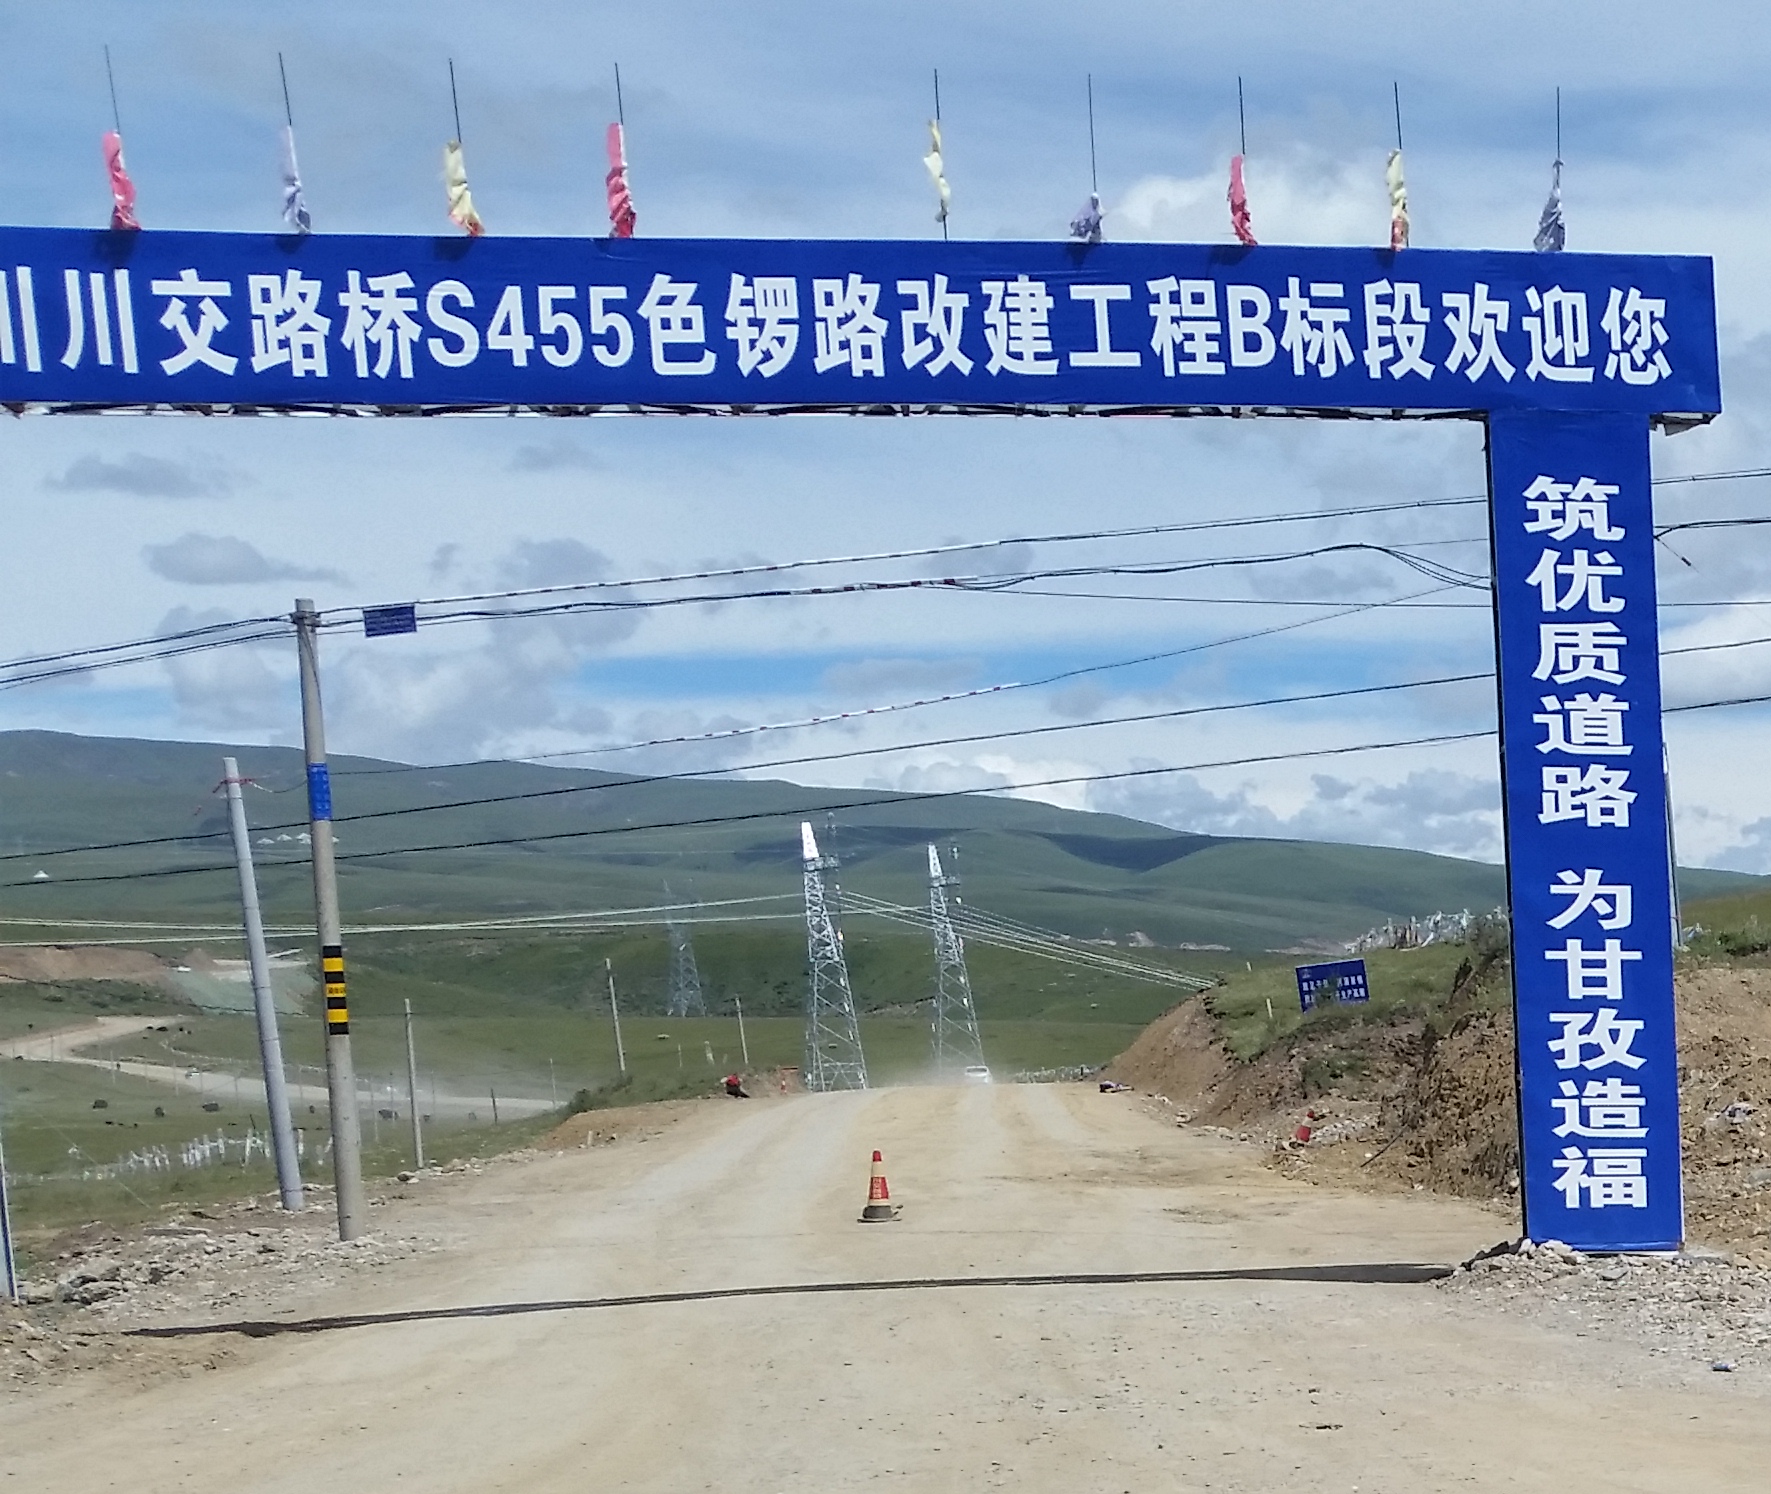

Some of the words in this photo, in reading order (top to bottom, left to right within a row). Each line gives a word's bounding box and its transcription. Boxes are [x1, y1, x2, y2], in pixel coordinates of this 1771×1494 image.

[1523, 475, 1637, 828] 筑优质道路
[1545, 869, 1649, 1208] 为甘孜造福
